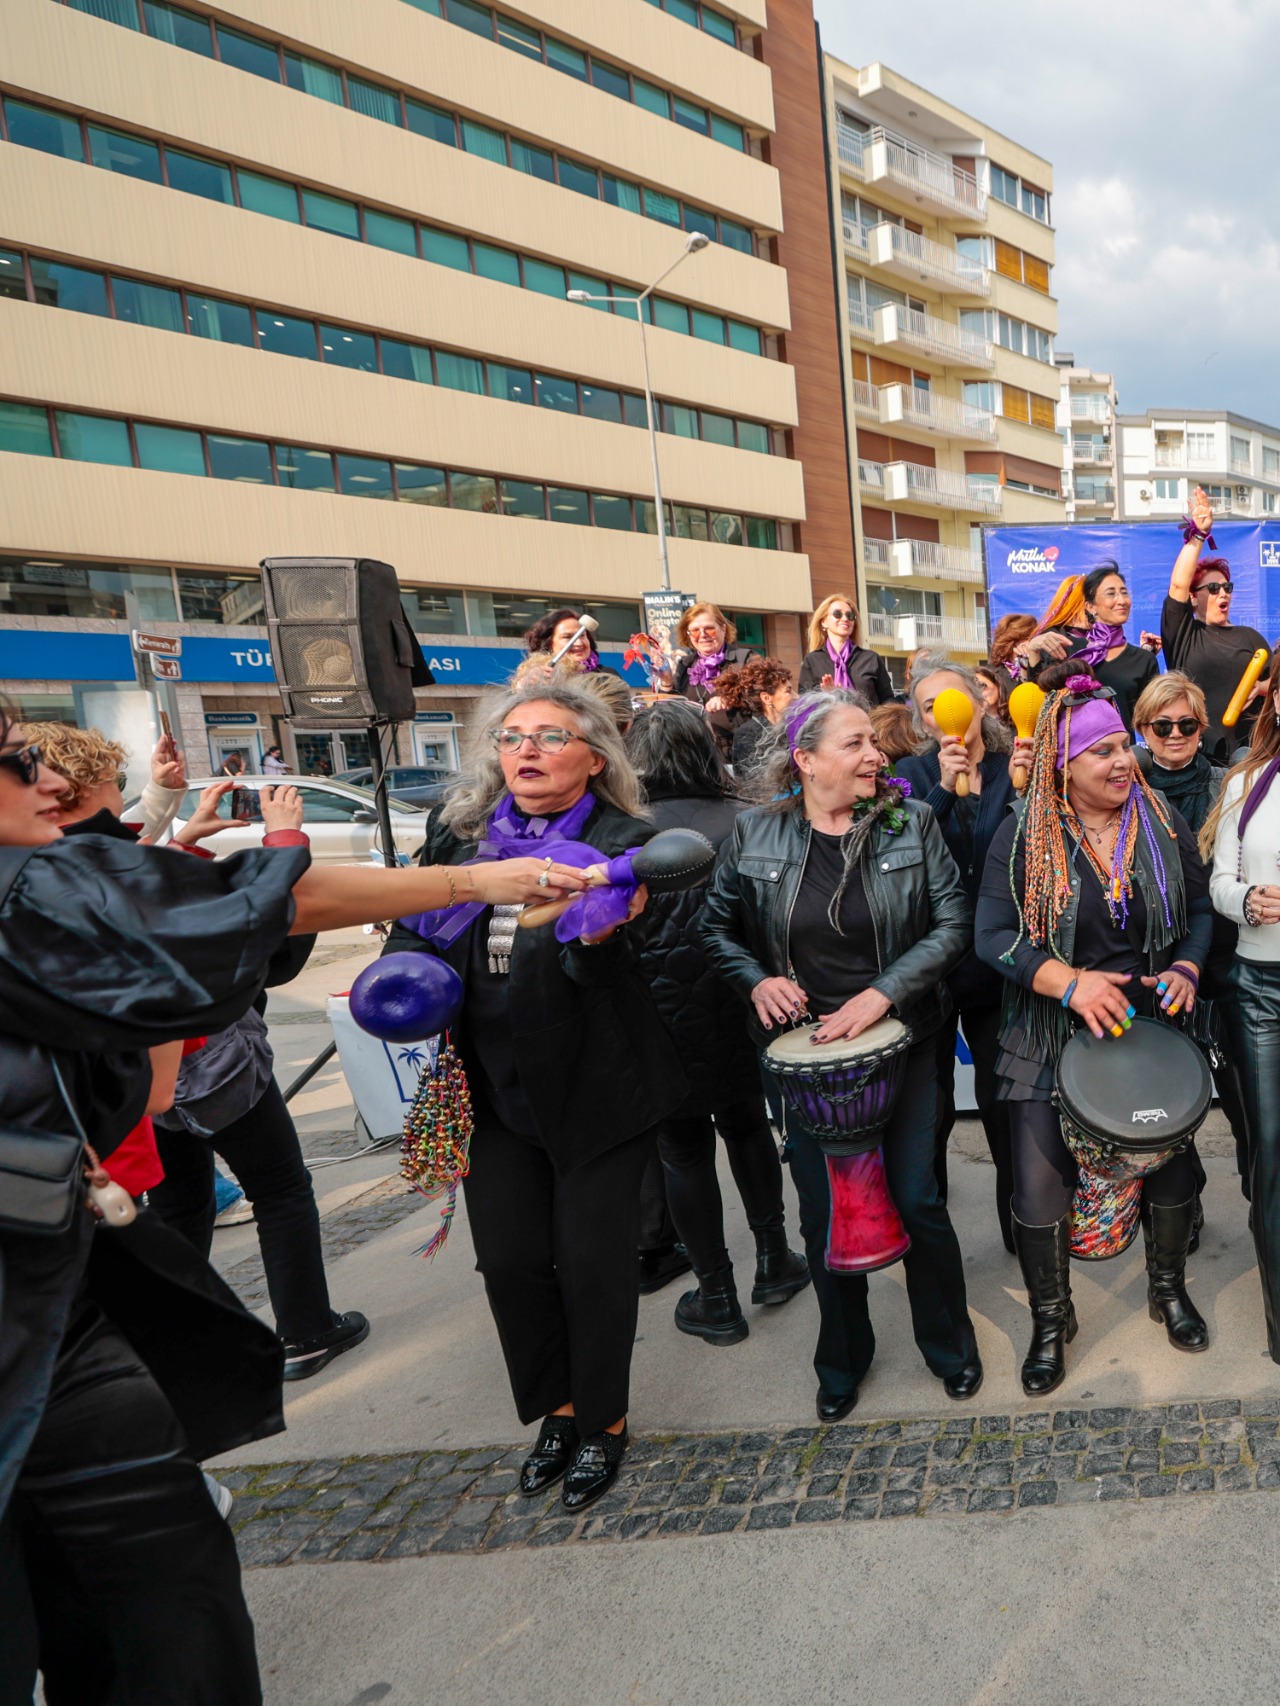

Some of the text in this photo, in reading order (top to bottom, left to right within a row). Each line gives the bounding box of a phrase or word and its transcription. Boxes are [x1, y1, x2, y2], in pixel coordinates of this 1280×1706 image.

[1007, 546, 1047, 567] Mutlu
[1012, 561, 1056, 573] KONAK
[647, 607, 681, 617] Online
[424, 657, 461, 671] ASI
